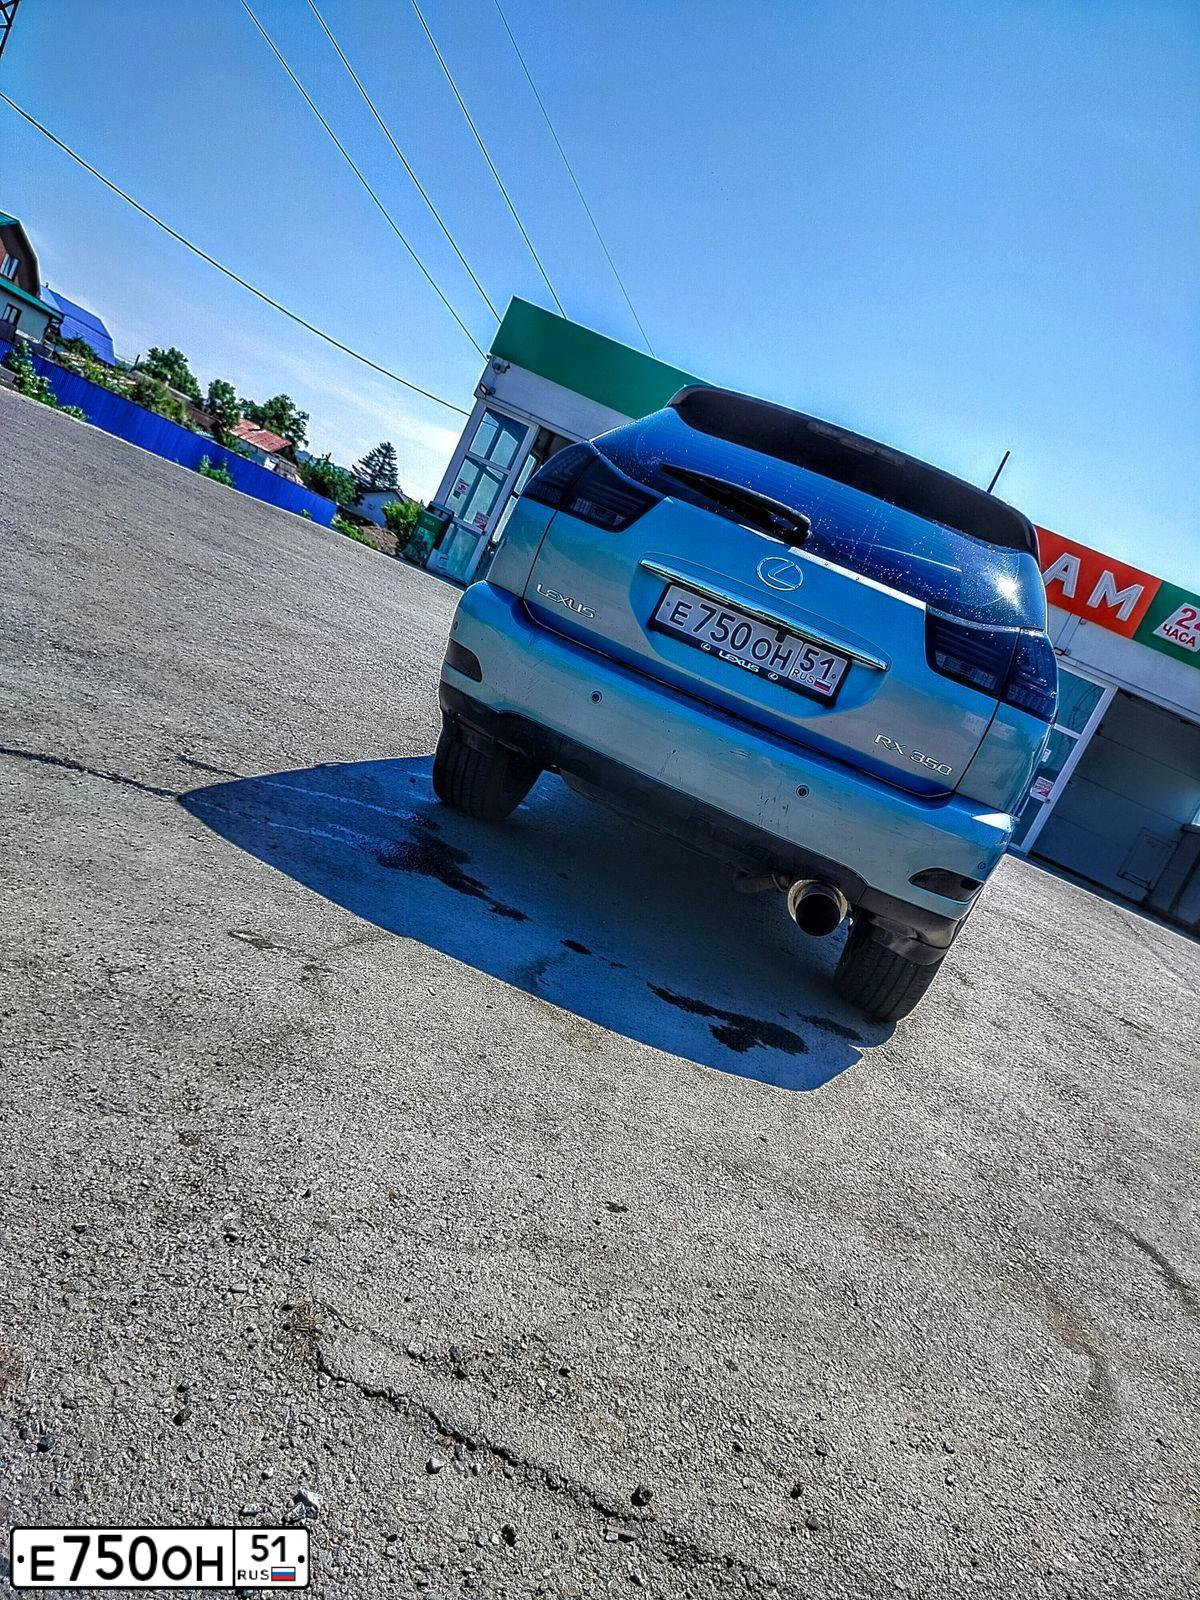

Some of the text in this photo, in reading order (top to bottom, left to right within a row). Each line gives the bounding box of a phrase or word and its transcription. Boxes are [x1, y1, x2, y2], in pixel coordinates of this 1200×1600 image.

[536, 583, 597, 619] LEXUS
[1163, 624, 1196, 648] ЧАСА
[718, 650, 760, 673] LEXUS
[791, 667, 815, 684] RUS
[800, 648, 834, 680] 51
[874, 734, 953, 776] RX 350
